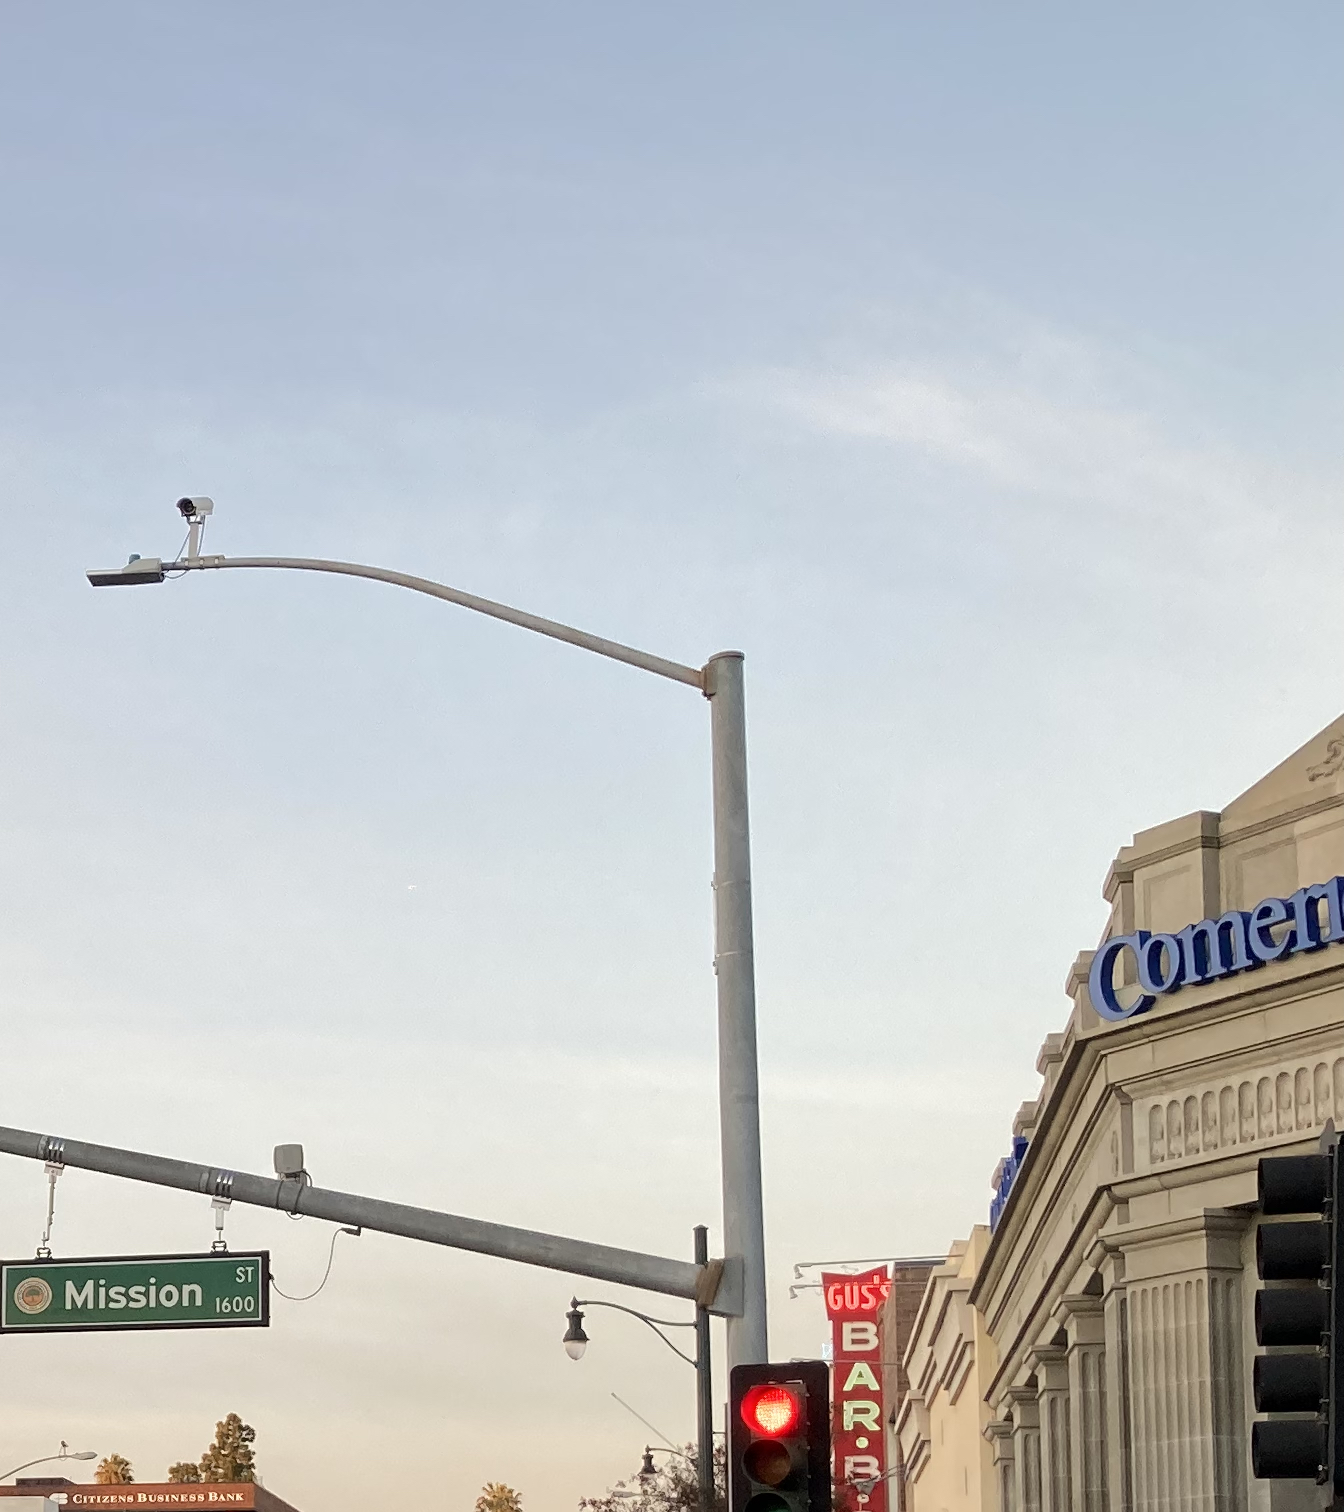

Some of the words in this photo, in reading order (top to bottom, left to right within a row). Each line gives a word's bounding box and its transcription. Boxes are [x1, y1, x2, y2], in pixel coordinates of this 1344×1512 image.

[236, 1267, 255, 1283] ST
[64, 1277, 203, 1310] Mission
[216, 1296, 254, 1313] 1600
